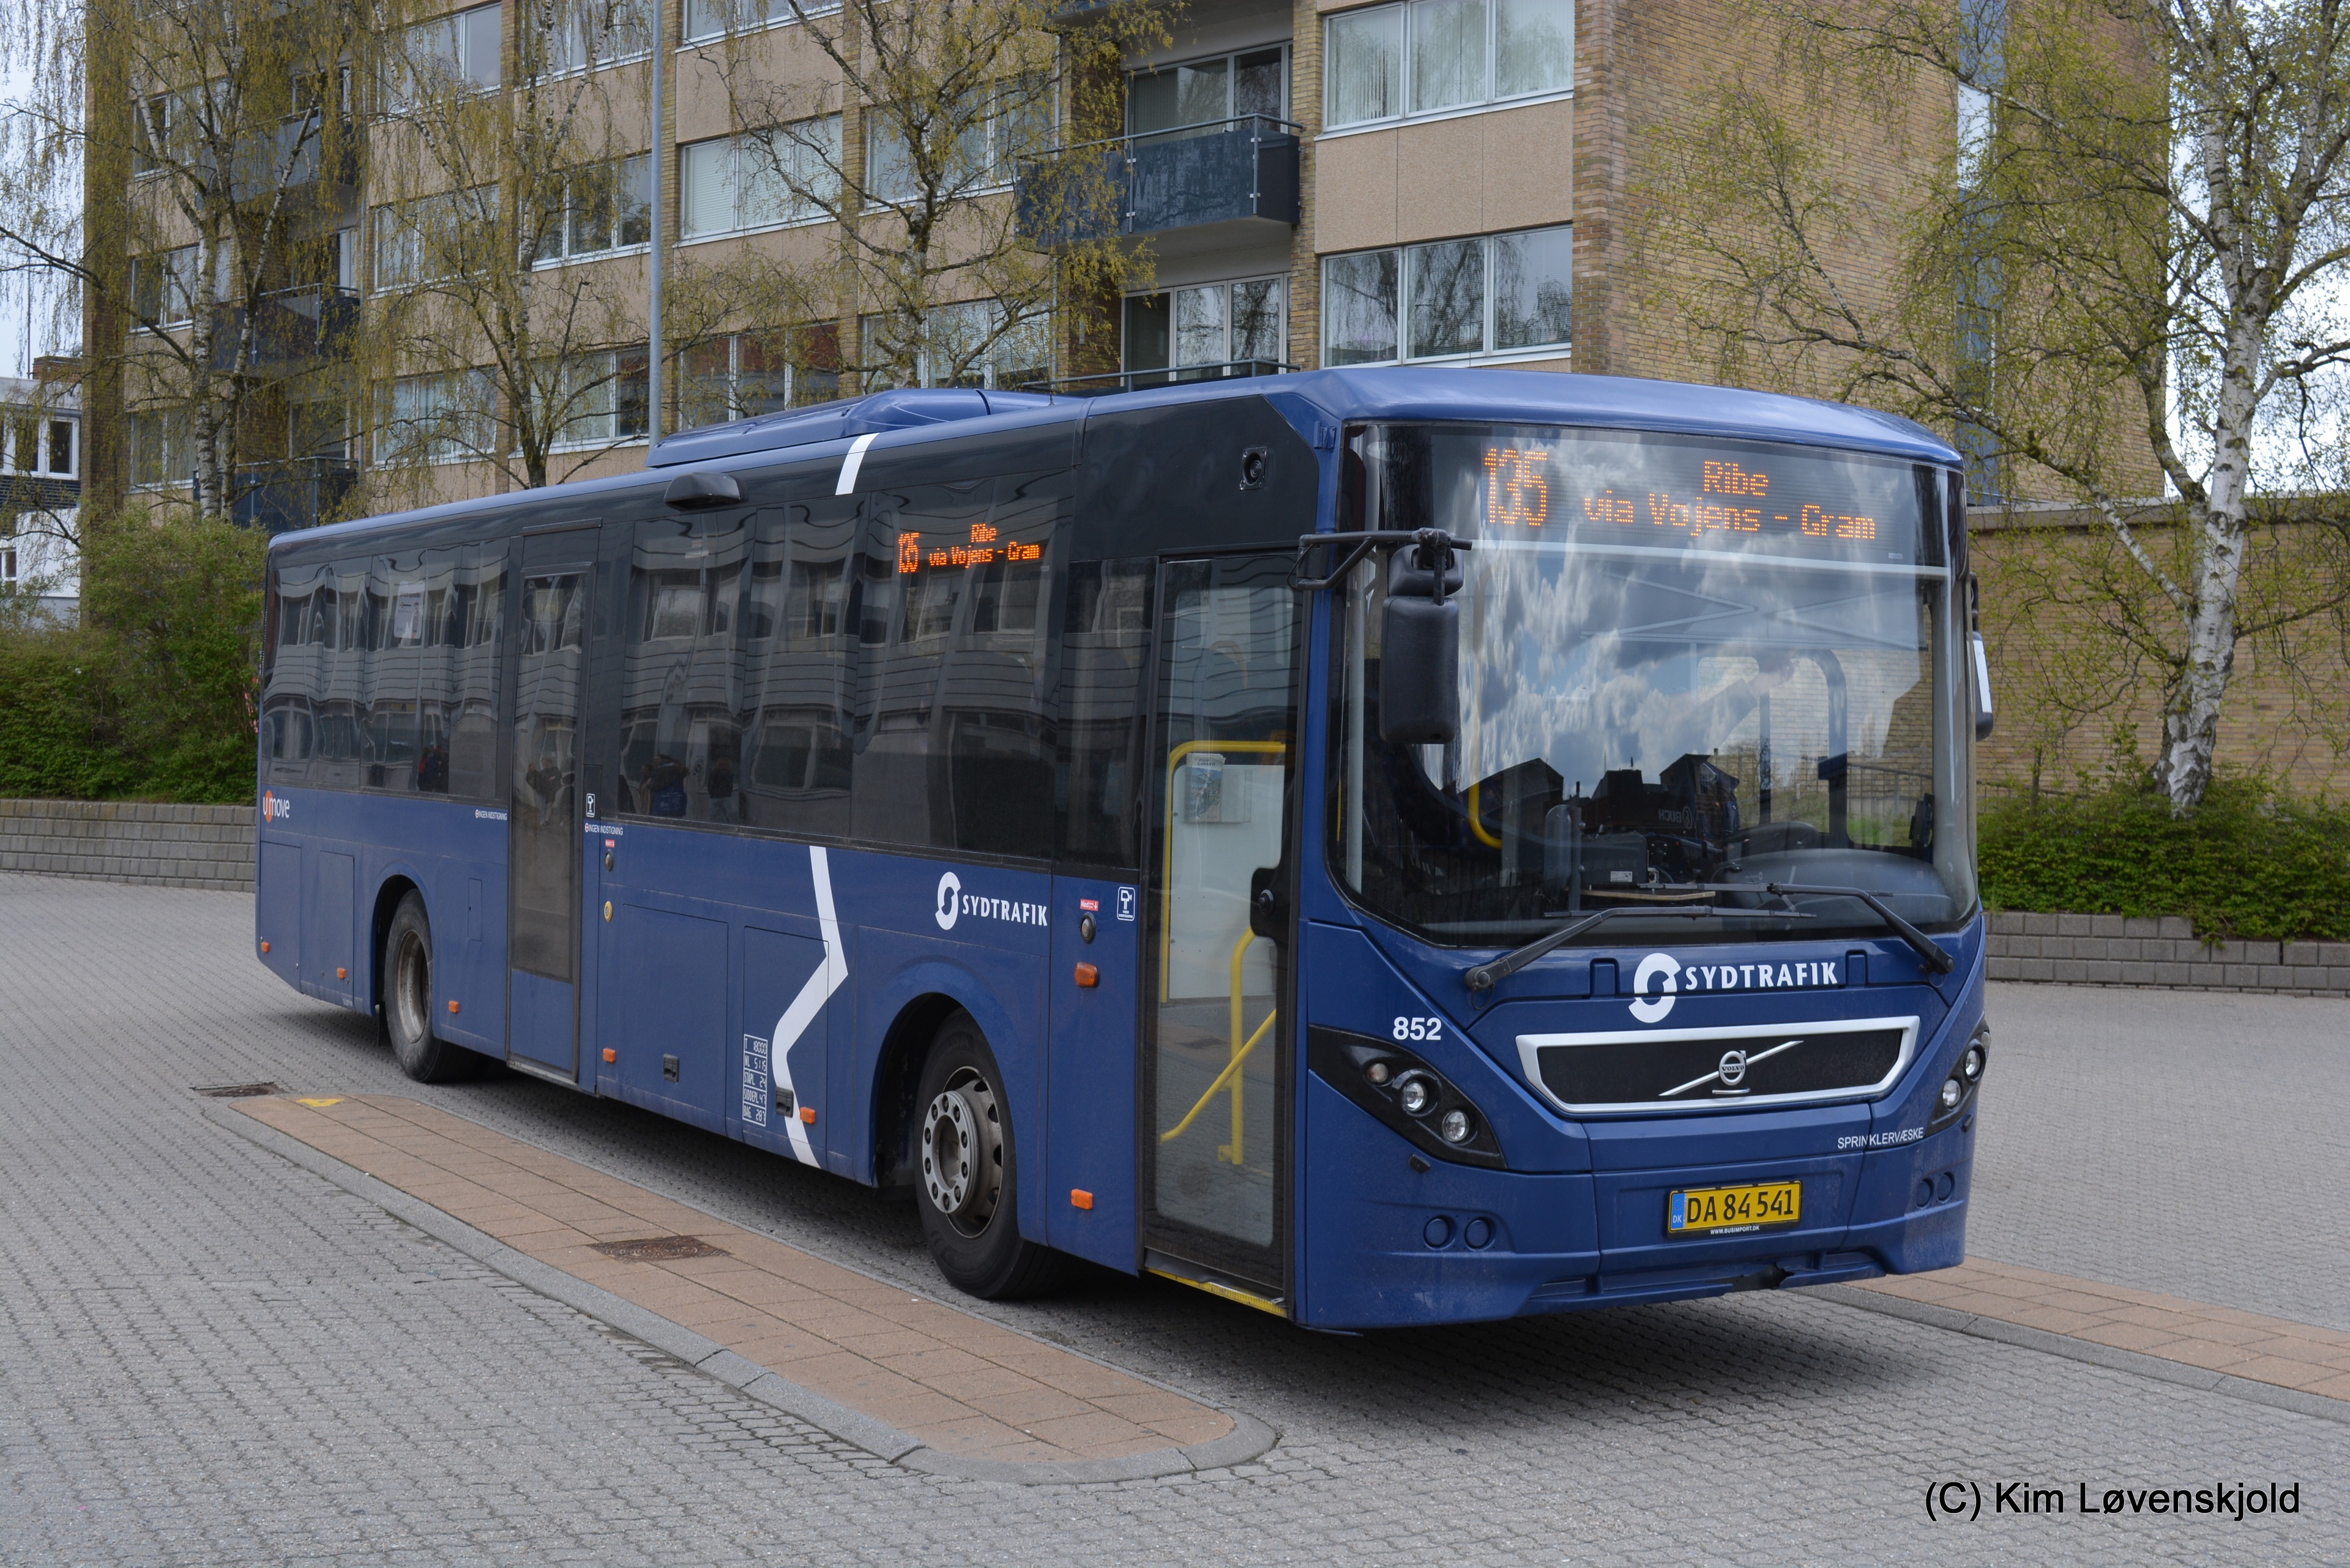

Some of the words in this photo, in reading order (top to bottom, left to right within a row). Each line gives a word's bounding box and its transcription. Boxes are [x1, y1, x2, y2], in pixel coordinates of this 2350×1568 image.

[1484, 448, 1547, 526] 135
[1704, 460, 1768, 496] Ribe
[1584, 490, 1633, 523] via
[1649, 493, 1761, 537] Vojens
[1801, 504, 1875, 540] Gram
[971, 523, 997, 542] Ribe
[929, 548, 947, 566] via
[951, 545, 993, 569] Vojens
[1008, 542, 1040, 560] Gram
[962, 894, 1048, 927] SYDTRAFIK
[1685, 961, 1838, 990] SYDTRAFIK
[1393, 1016, 1442, 1040] 852
[1673, 1214, 1682, 1223] DK
[1687, 1195, 1717, 1223] DA
[1723, 1192, 1751, 1221] 84
[1756, 1189, 1794, 1218] 541
[1710, 1225, 1760, 1235] WWW.BUSIMPORT.DK
